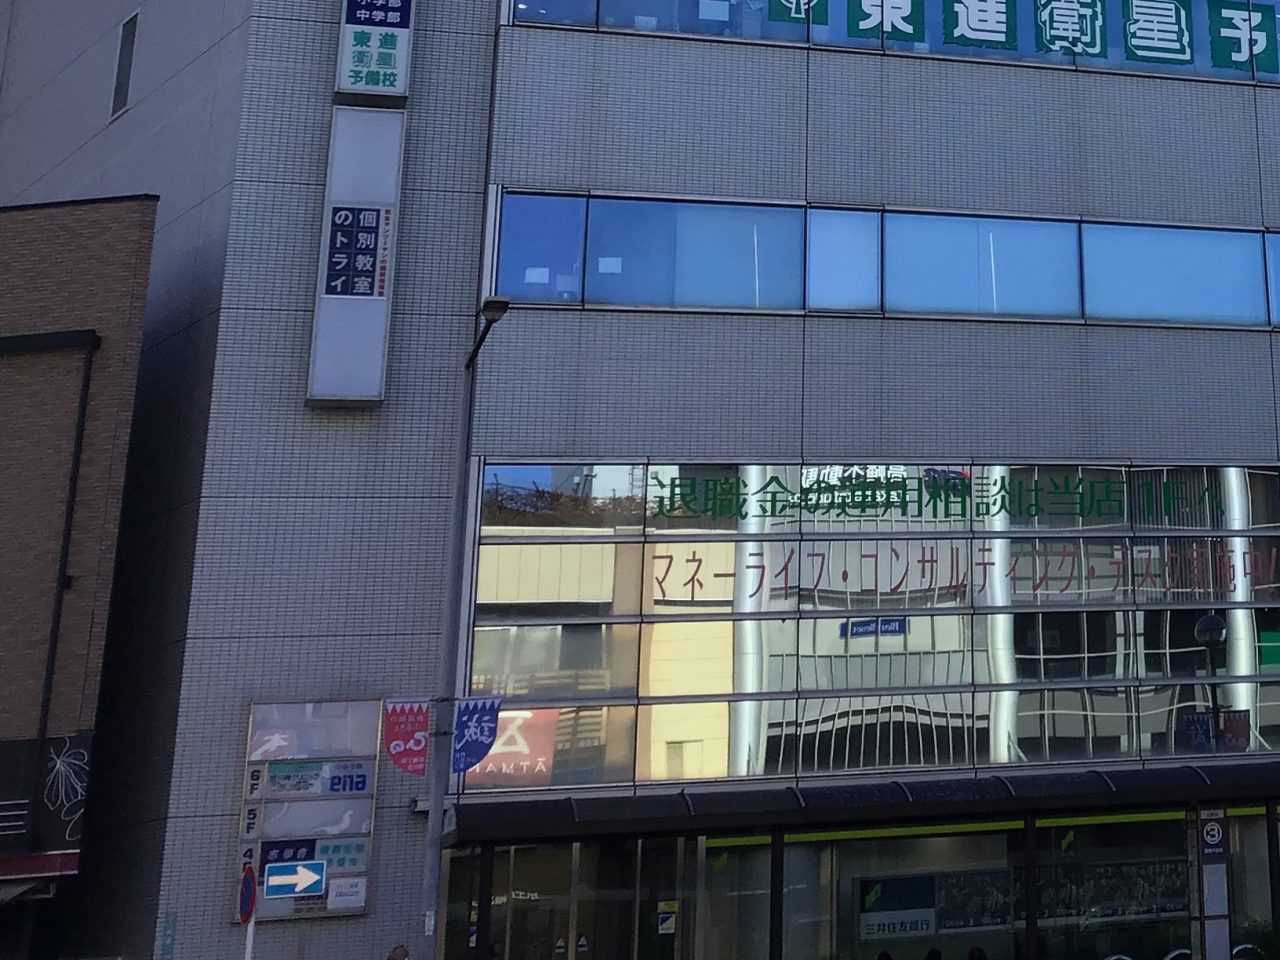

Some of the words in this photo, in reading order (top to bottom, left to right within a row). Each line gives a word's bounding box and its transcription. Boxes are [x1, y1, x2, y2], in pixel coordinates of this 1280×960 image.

[356, 9, 401, 24] 中学部
[352, 31, 399, 51] 東進
[351, 49, 397, 70] 衛星
[347, 70, 398, 89] 予備校
[330, 210, 353, 292] のトライ
[352, 210, 377, 294] 個別教室
[329, 773, 367, 793] ena
[865, 918, 931, 935] 三井住友銀行
